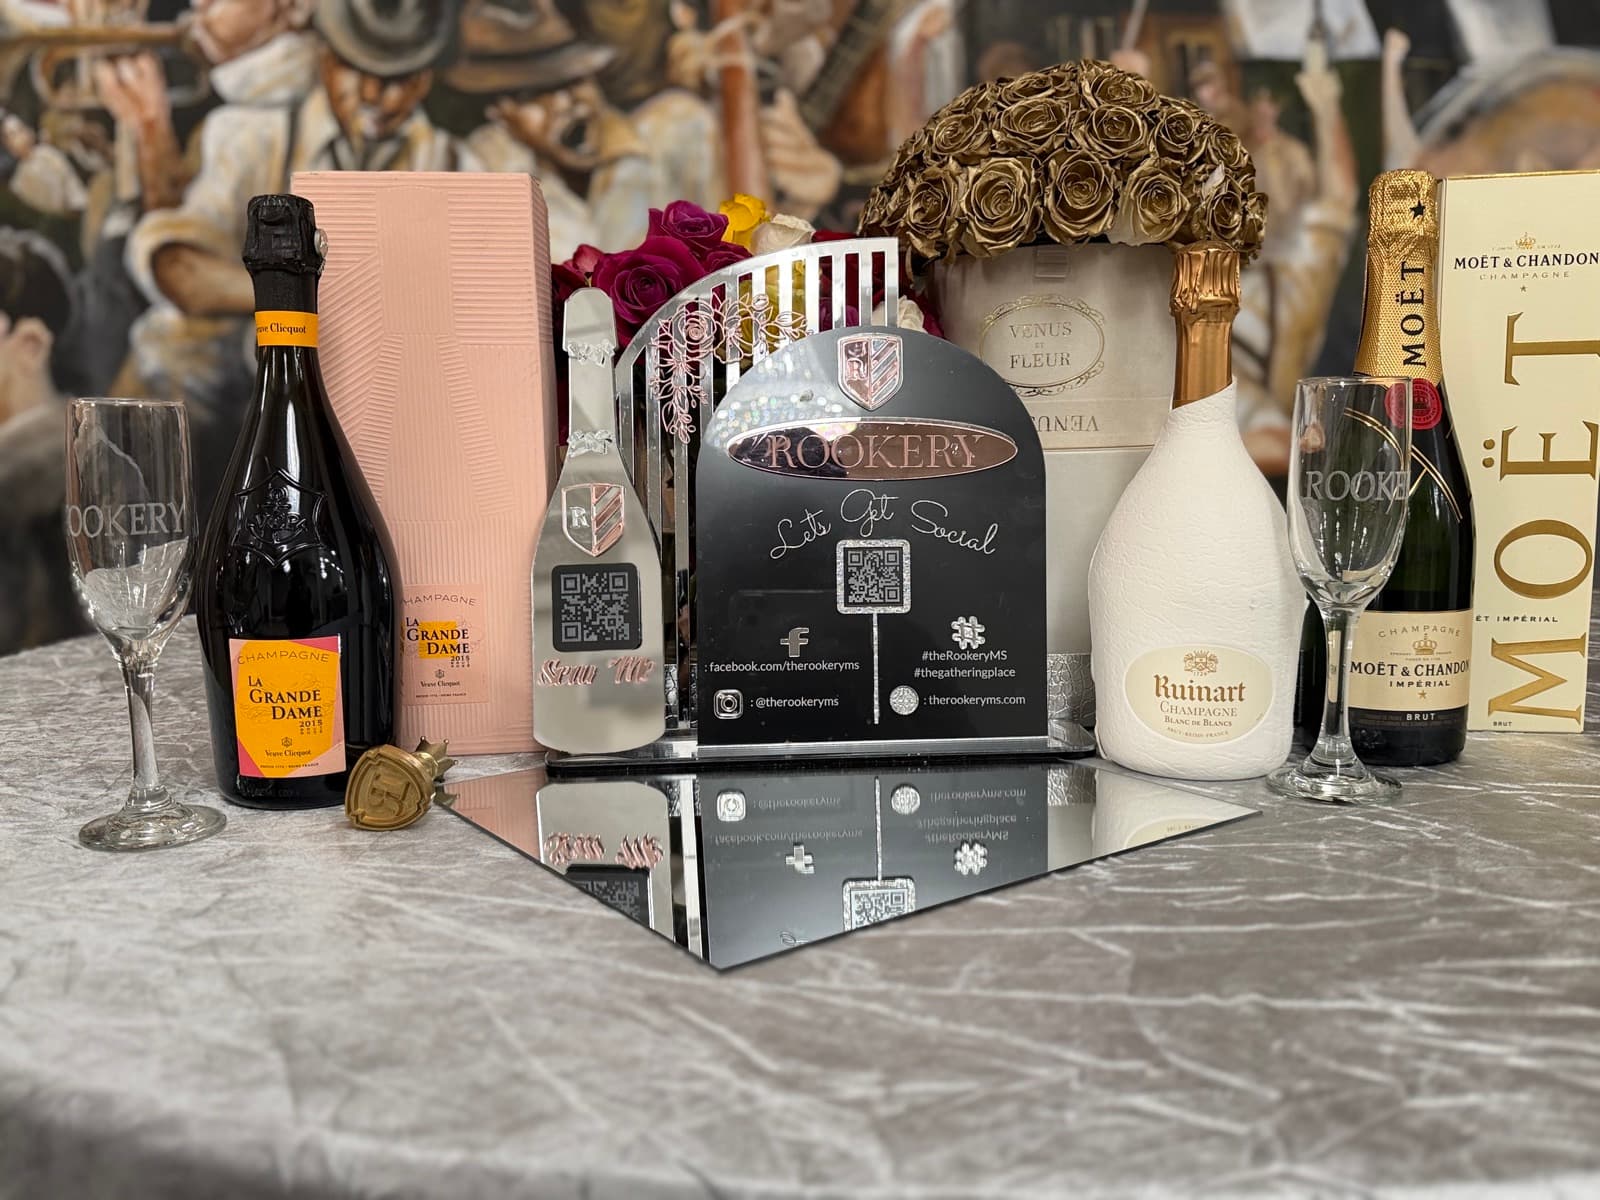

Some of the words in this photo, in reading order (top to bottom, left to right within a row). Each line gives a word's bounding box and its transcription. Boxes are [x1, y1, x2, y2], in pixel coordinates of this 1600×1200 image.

[1453, 254, 1501, 270] MOËT
[1503, 257, 1513, 268] &
[1516, 251, 1600, 268] CHANDON
[1479, 271, 1570, 281] CHAMPAGNE
[1395, 260, 1427, 367] MOËT
[270, 321, 306, 335] Clicquot
[1009, 321, 1072, 339] VENUS
[1010, 352, 1071, 369] FLEUR
[1032, 415, 1099, 433] VENU
[765, 433, 984, 470] ROOKERY
[1303, 470, 1411, 502] ROOKE
[66, 501, 186, 538] OOKERY
[569, 506, 590, 529] R
[840, 488, 899, 538] Get
[911, 500, 999, 555] Social
[1482, 311, 1600, 727] MOËT
[402, 593, 477, 607] HAMPAGNE
[405, 617, 419, 627] LA
[1497, 615, 1559, 623] IMPÉRIAL
[406, 628, 470, 642] GRANDE
[1378, 625, 1461, 638] CHAMPAGNE
[427, 642, 470, 655] DAME
[237, 650, 330, 665] CHAMPAGNE
[921, 650, 1008, 663] #theRookeryMS
[914, 667, 1016, 680] #thegatheringplace
[1350, 661, 1398, 677] MOËT
[1400, 666, 1411, 677] &
[1414, 659, 1470, 676] CHANDON
[248, 675, 263, 688] LA
[420, 680, 436, 688] Veuve
[1153, 674, 1246, 703] Ruinart
[1389, 680, 1451, 688] IMPÉRIAL
[249, 689, 322, 704] GRANDE
[755, 697, 839, 709] @therookeryms
[928, 694, 1026, 707] therookeryms.com
[271, 706, 323, 720] DAME
[1160, 701, 1238, 718] CHAMPAGNE
[1164, 716, 1190, 726] BLANC
[1203, 719, 1233, 728] BLANCS
[1406, 713, 1436, 721] BRUT
[265, 749, 283, 758] Veuve
[284, 748, 312, 757] Clicquot
